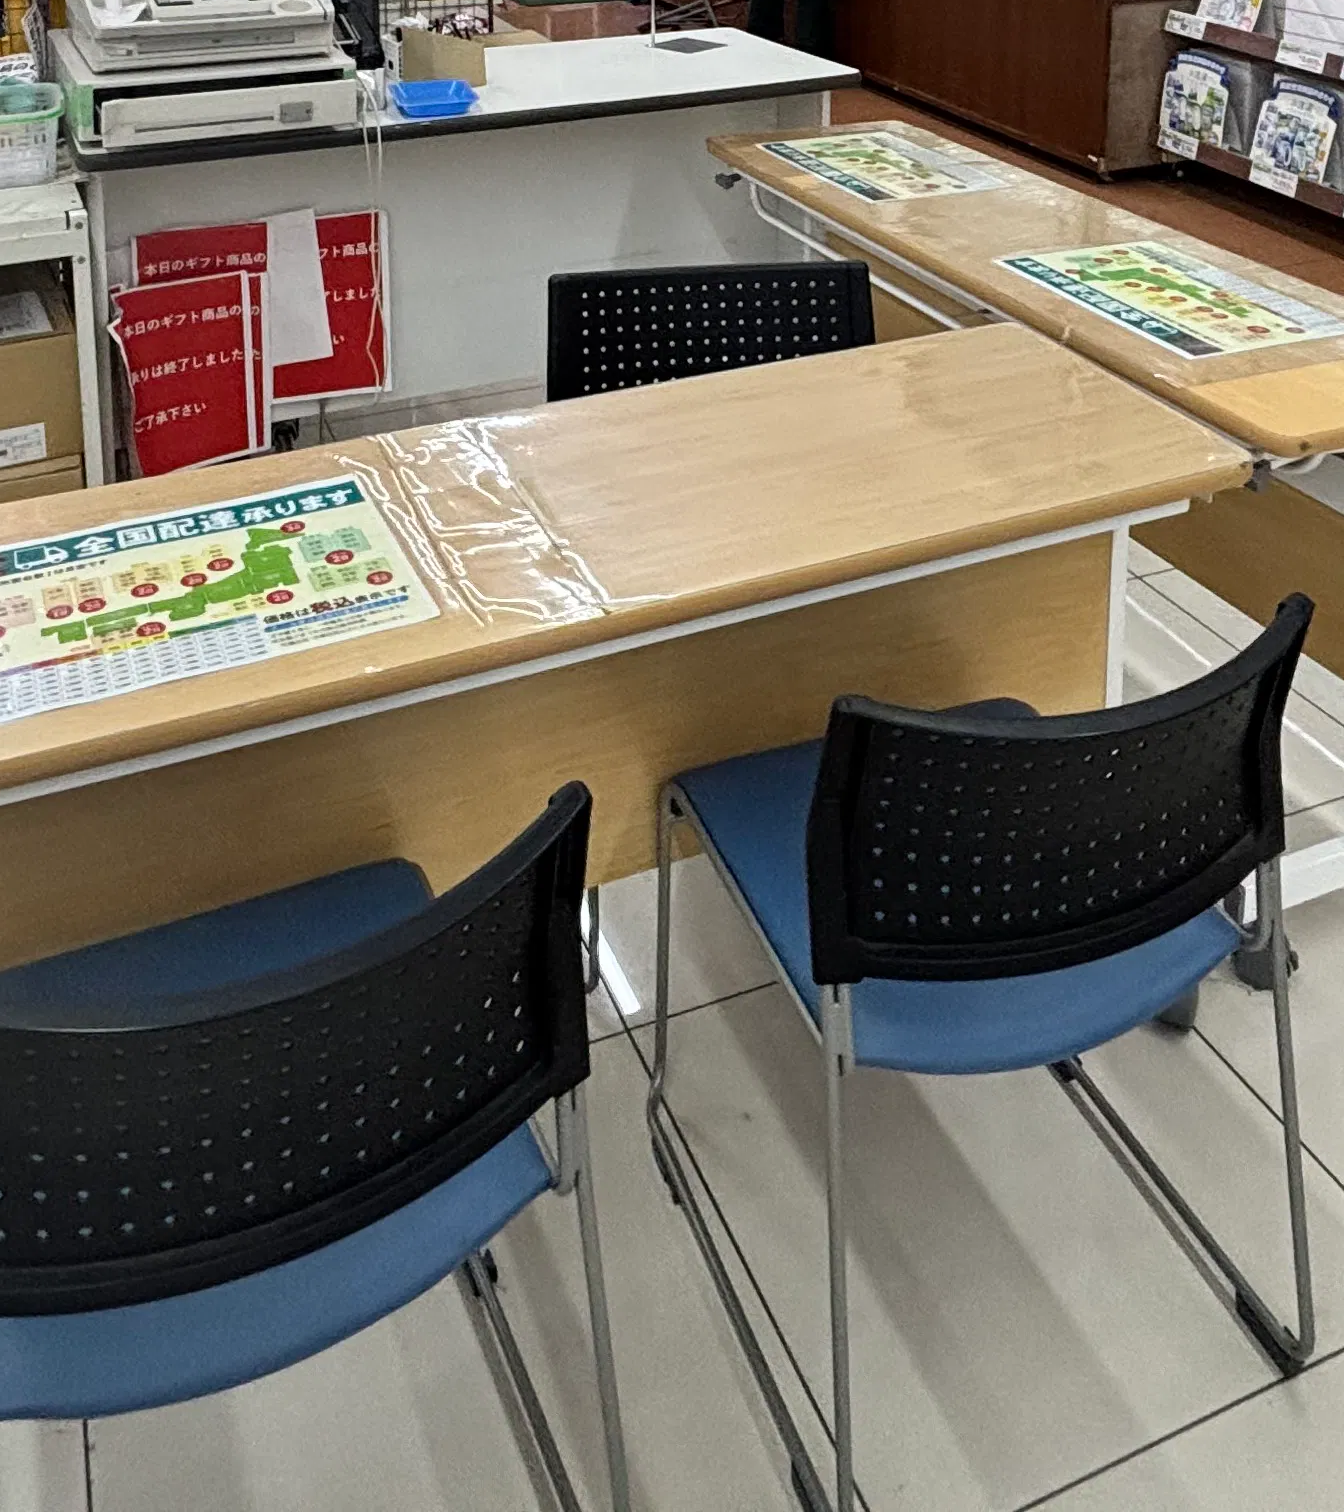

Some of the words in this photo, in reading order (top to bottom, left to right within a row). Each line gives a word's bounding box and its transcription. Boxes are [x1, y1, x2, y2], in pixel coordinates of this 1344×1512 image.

[144, 252, 267, 276] 本日のギフト商品の
[123, 304, 242, 339] 本日のギフト商品の
[134, 403, 207, 433] ご了承下さい
[73, 488, 354, 558] 全国配達承ります
